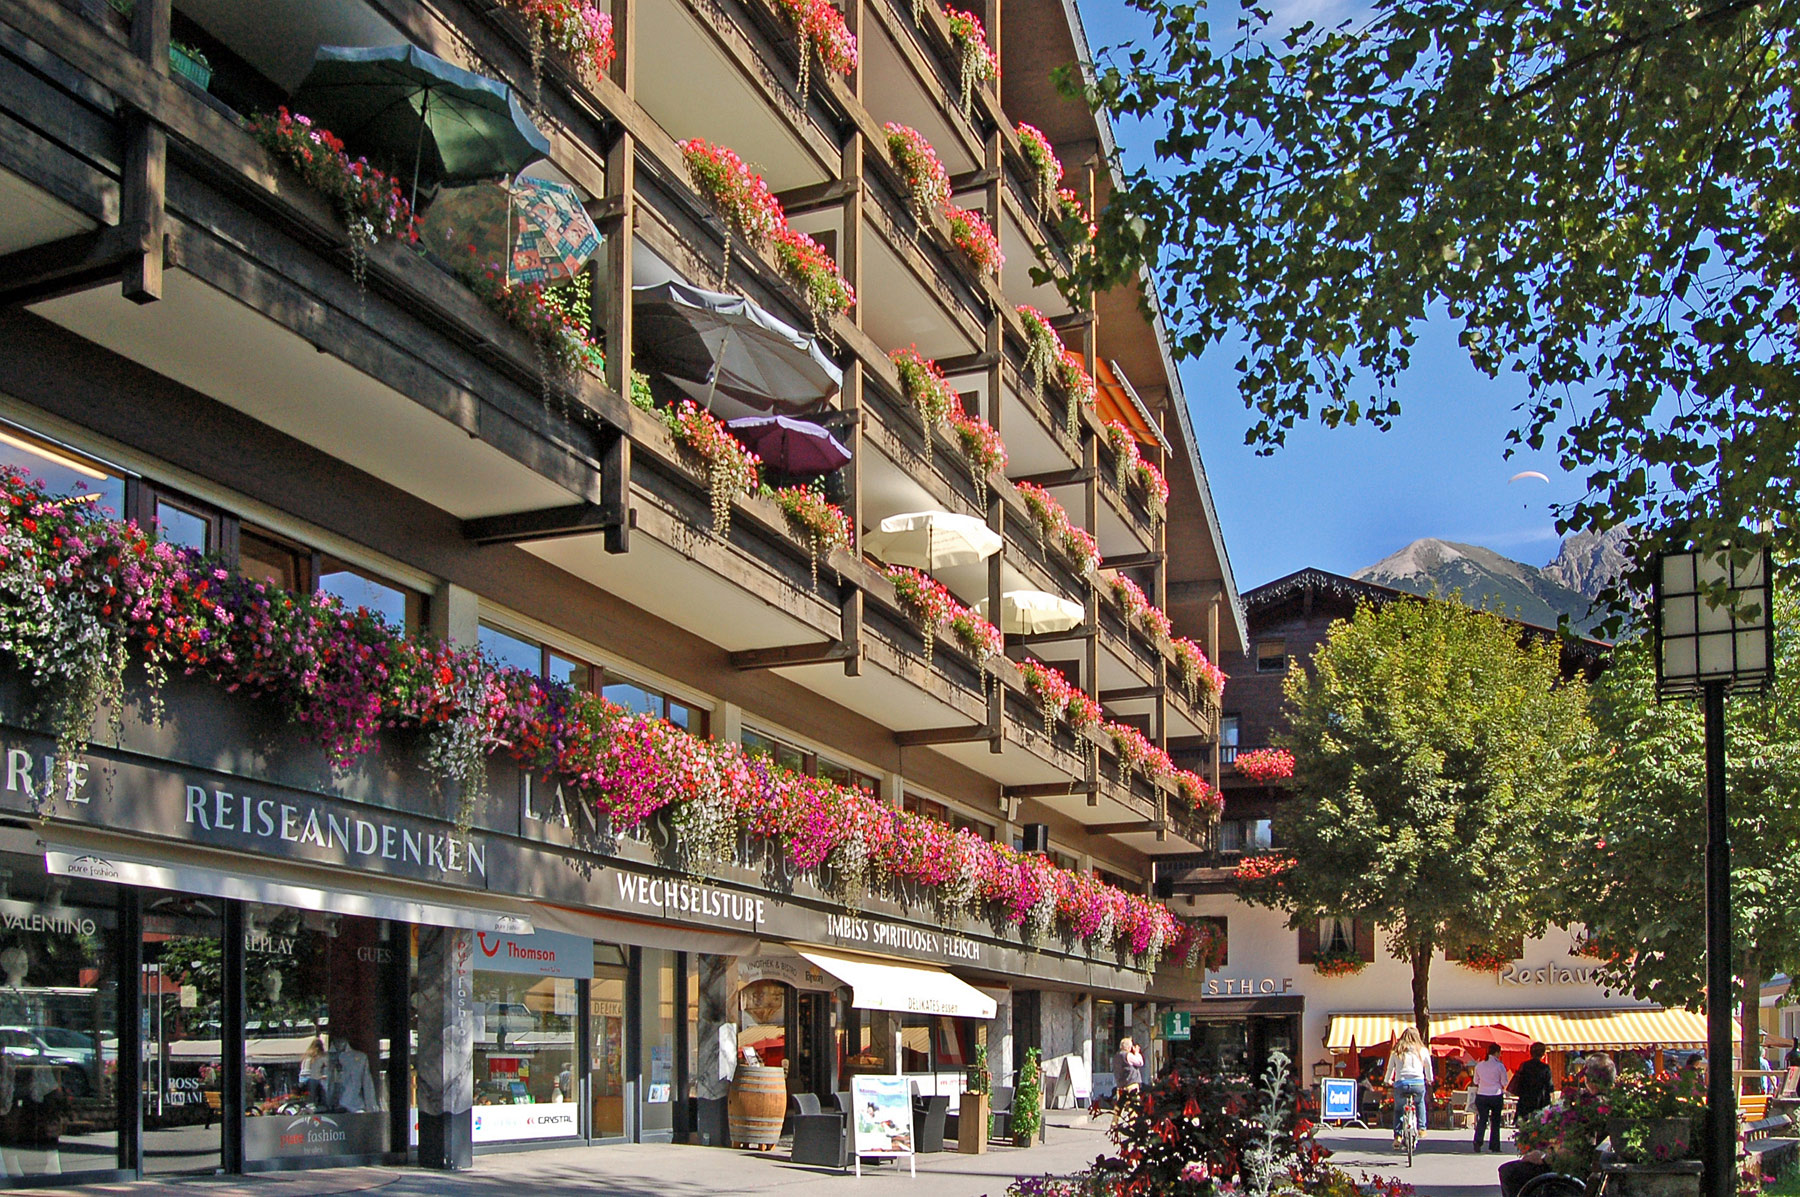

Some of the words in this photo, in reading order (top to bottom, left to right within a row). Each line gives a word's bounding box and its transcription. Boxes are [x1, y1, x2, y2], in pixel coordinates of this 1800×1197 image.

[185, 785, 486, 877] REISEANDENKEN
[68, 864, 88, 873] pure
[90, 866, 119, 878] fashion
[617, 872, 766, 924] WECHSELSTUBE
[1, 911, 96, 936] VALENTINO
[827, 914, 869, 942] IMBISS
[873, 922, 939, 953] SPIRITUOSEN
[943, 937, 980, 960] FLEISCH
[507, 941, 556, 962] Thomson
[1497, 960, 1606, 986] Restau
[1208, 978, 1293, 995] STHOF
[457, 976, 467, 1038] fashio
[538, 1115, 573, 1125] CRYSTAL
[307, 1129, 345, 1143] fashion
